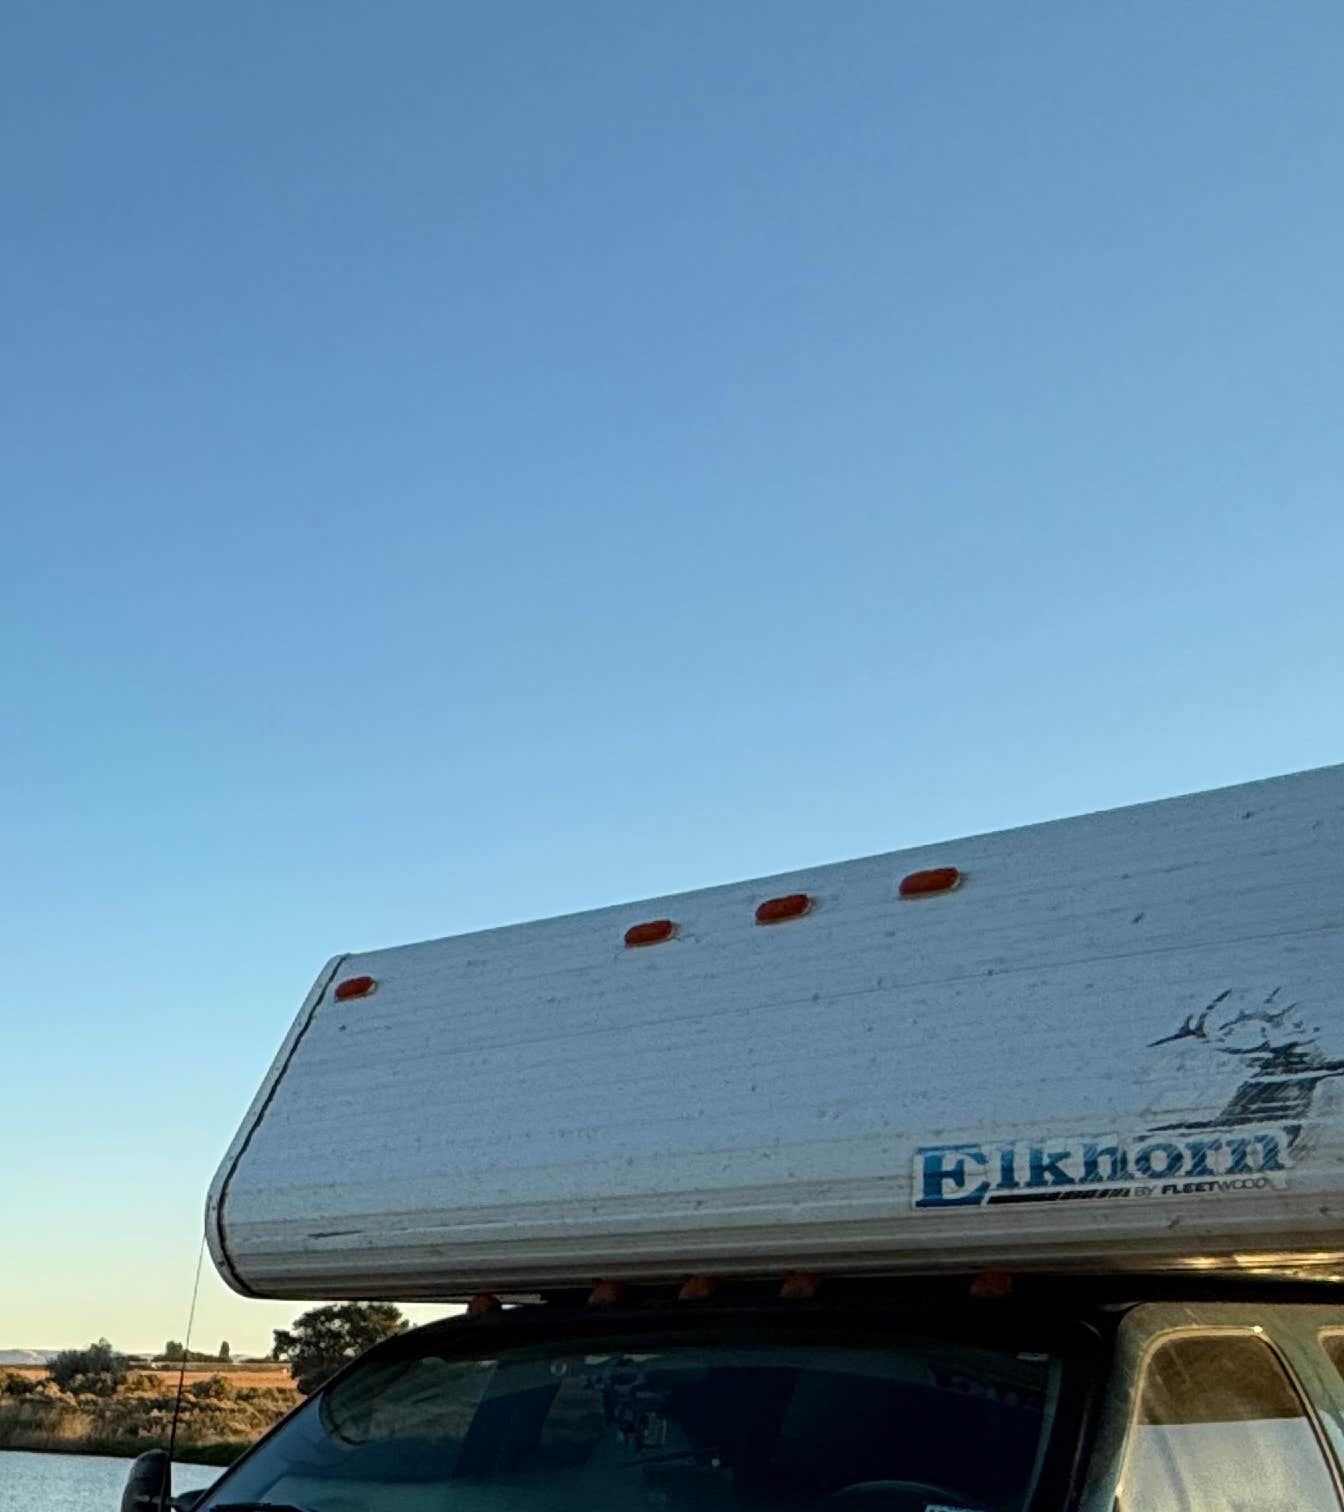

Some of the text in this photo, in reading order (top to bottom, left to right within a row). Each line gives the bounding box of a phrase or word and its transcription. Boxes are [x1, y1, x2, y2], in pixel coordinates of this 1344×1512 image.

[915, 1134, 1287, 1207] Elkhorn
[1134, 1177, 1268, 1198] BY FLEETWOOD
